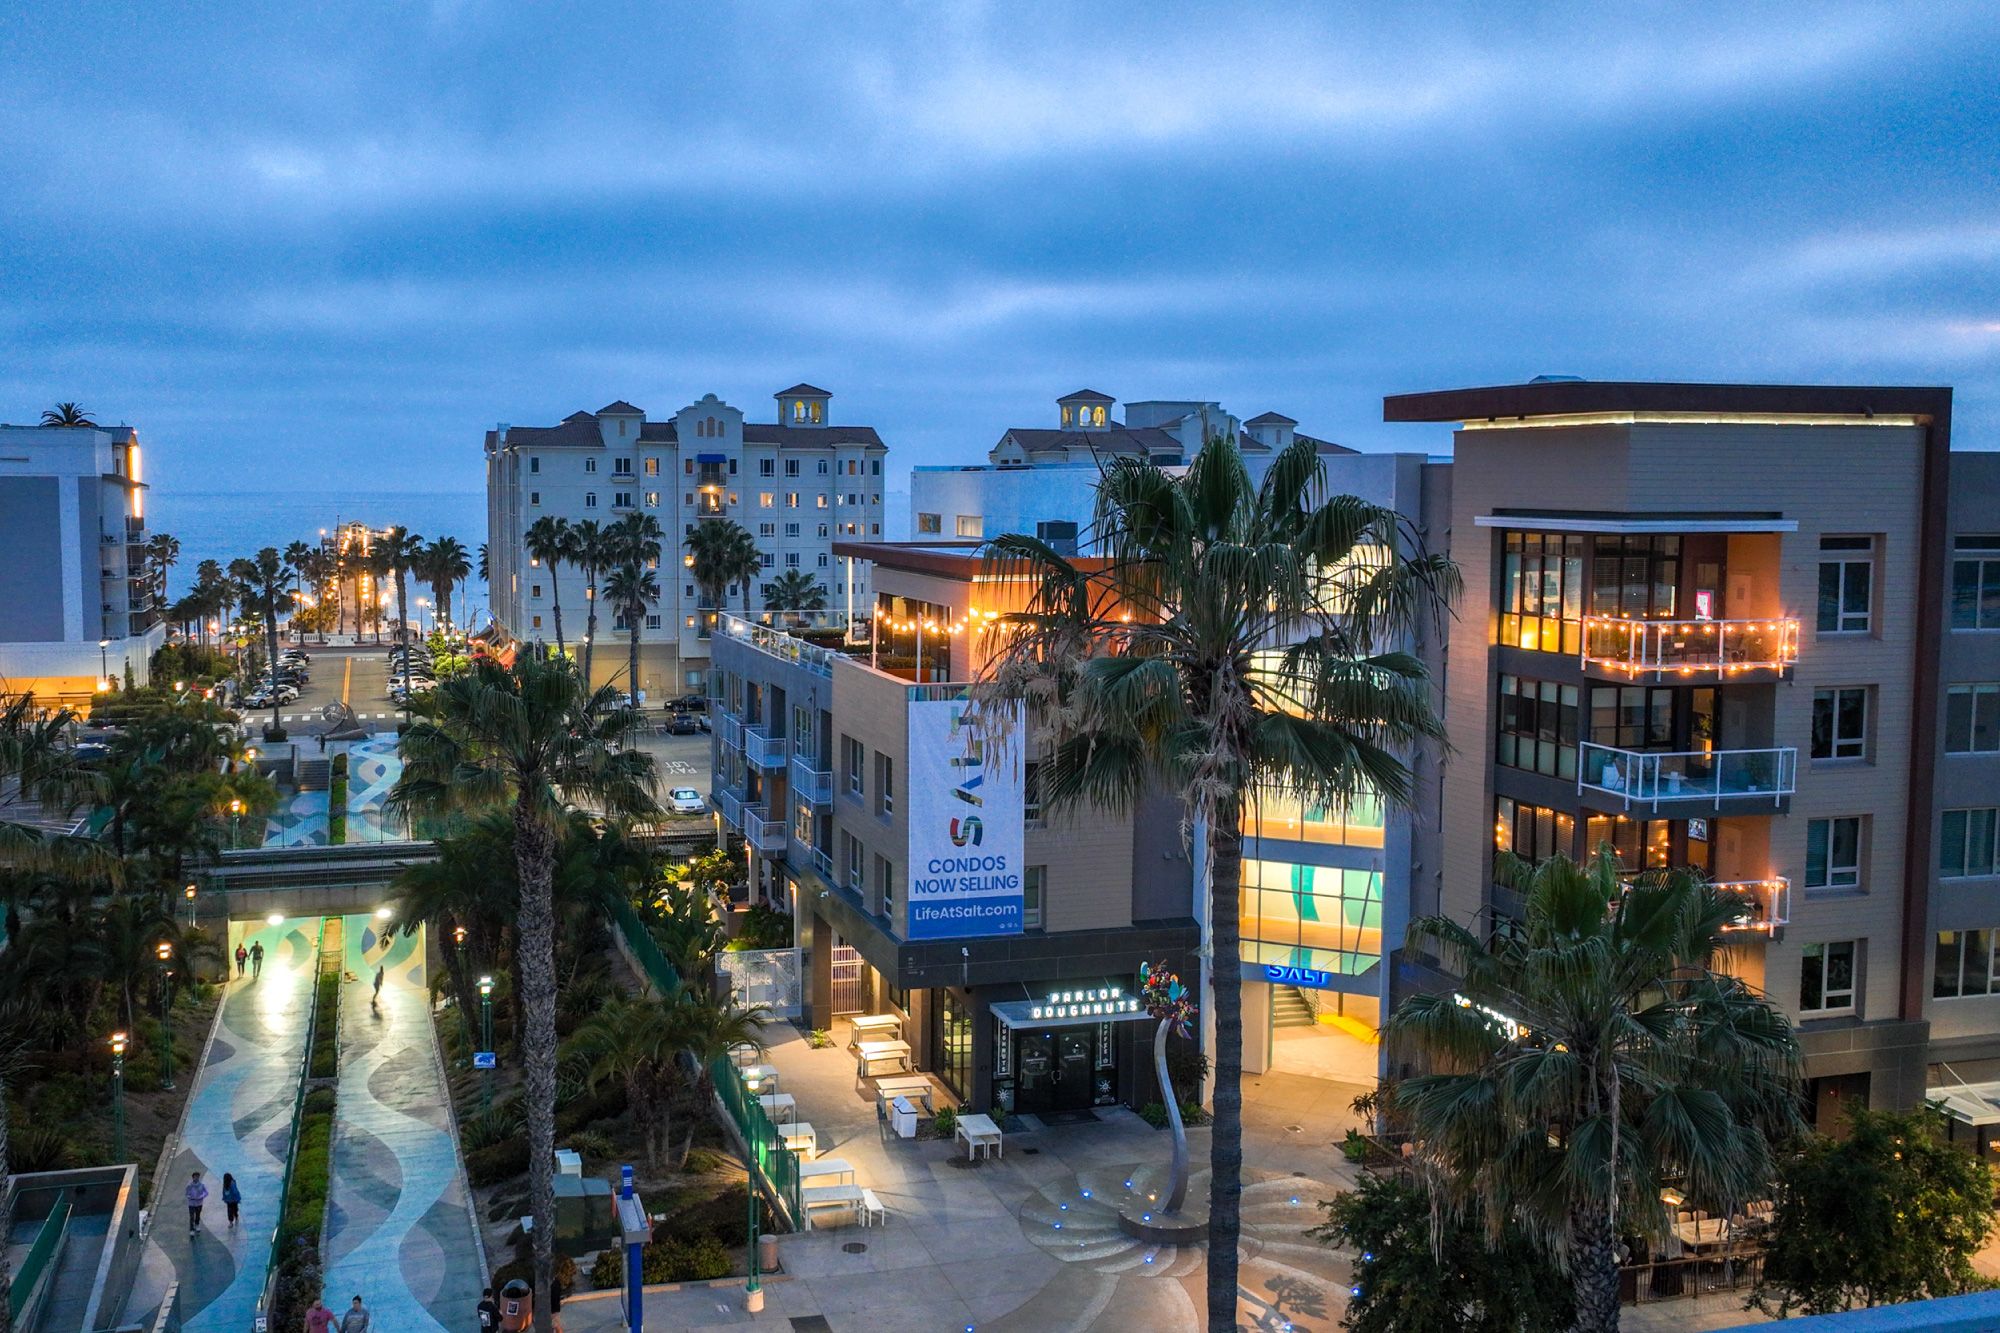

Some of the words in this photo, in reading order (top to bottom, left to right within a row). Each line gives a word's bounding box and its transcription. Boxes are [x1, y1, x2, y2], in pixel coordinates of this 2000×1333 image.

[950, 706, 983, 847] SALT
[928, 855, 1006, 874] CONDOS
[914, 878, 957, 894] NOW
[959, 875, 1019, 892] SELLING
[915, 904, 1018, 921] LifeAtSalt.com
[1268, 965, 1329, 985] SALT
[1051, 987, 1121, 1004] PARLOR
[1032, 1000, 1139, 1019] DOUGHNUTS
